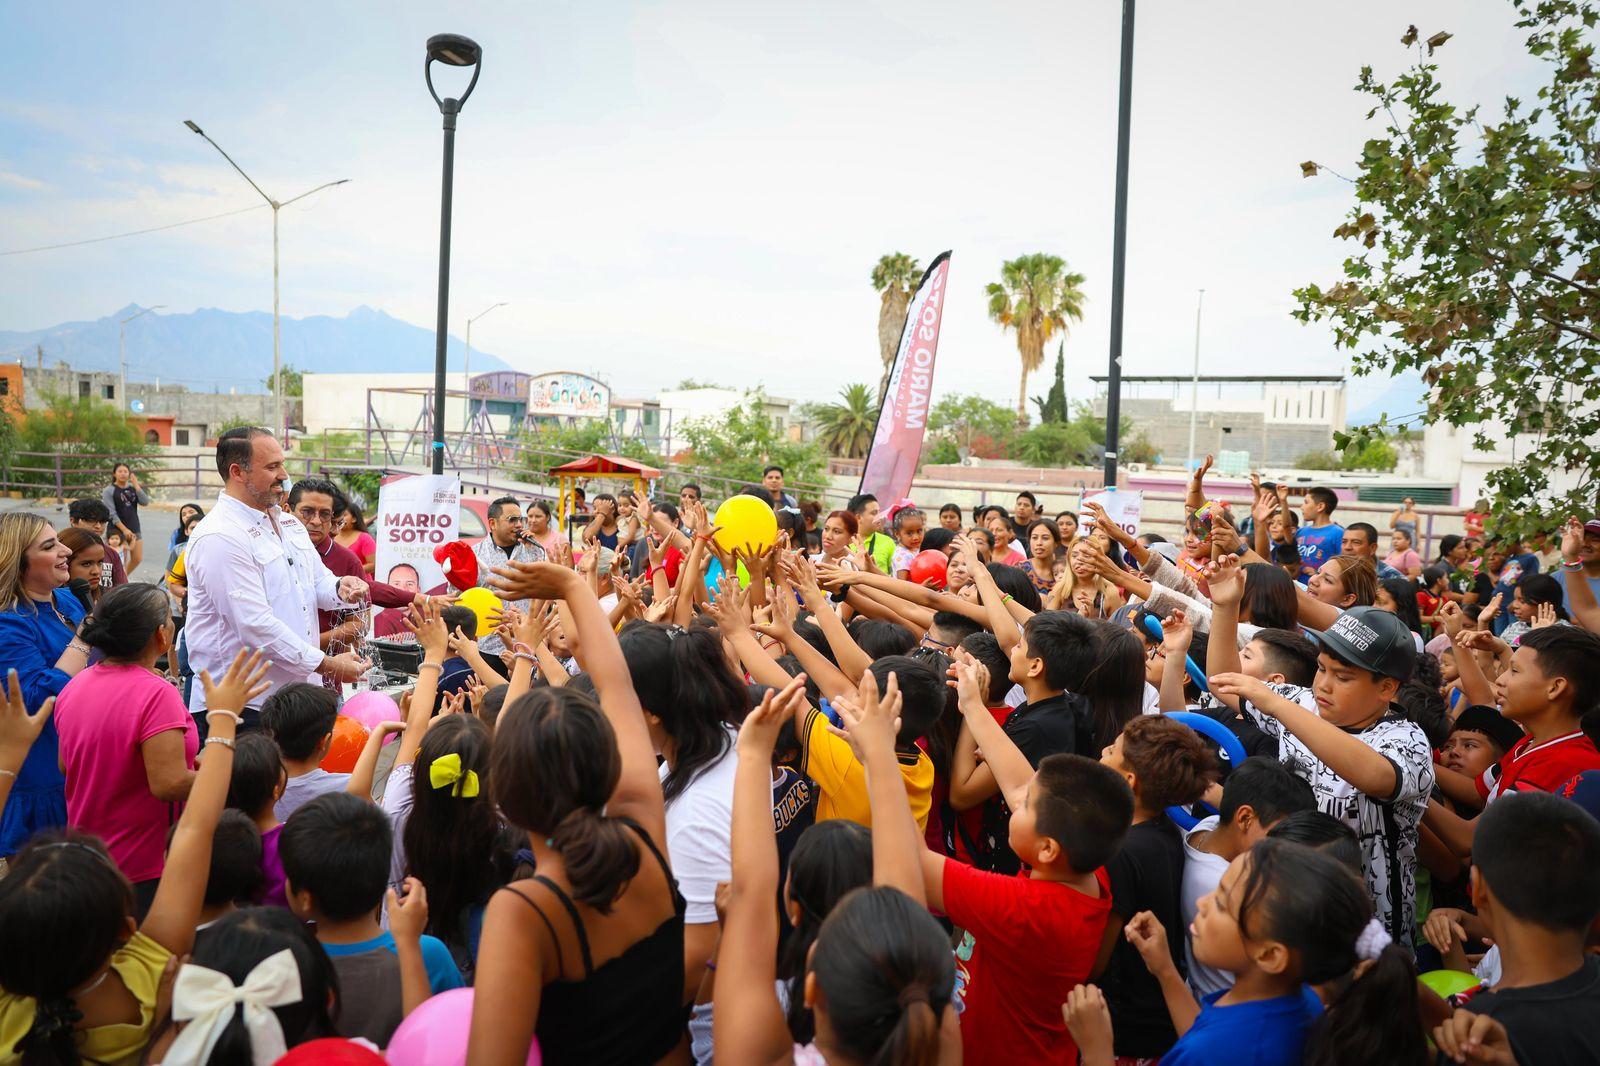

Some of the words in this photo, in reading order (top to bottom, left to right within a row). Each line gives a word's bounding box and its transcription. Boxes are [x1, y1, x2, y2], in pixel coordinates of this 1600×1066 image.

[384, 512, 452, 528] MARIO
[389, 529, 445, 543] SOTO
[772, 779, 811, 834] BUCKS
